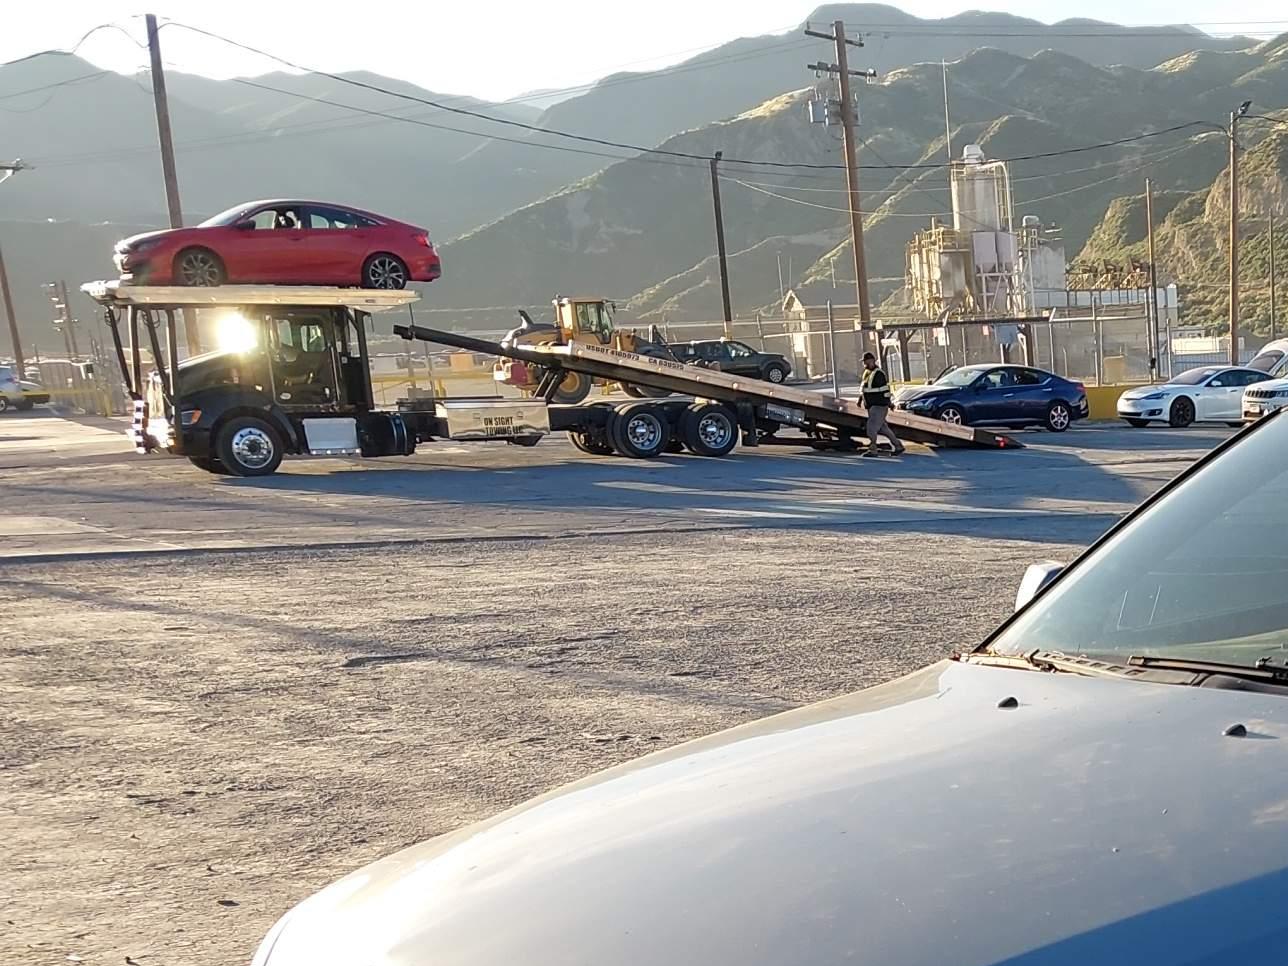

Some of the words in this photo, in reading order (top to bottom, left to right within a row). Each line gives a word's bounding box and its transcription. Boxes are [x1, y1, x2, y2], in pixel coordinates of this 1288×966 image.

[585, 344, 609, 355] USDOT
[483, 417, 494, 426] ON
[494, 416, 514, 426] SIGHT
[486, 425, 513, 437] TOWING
